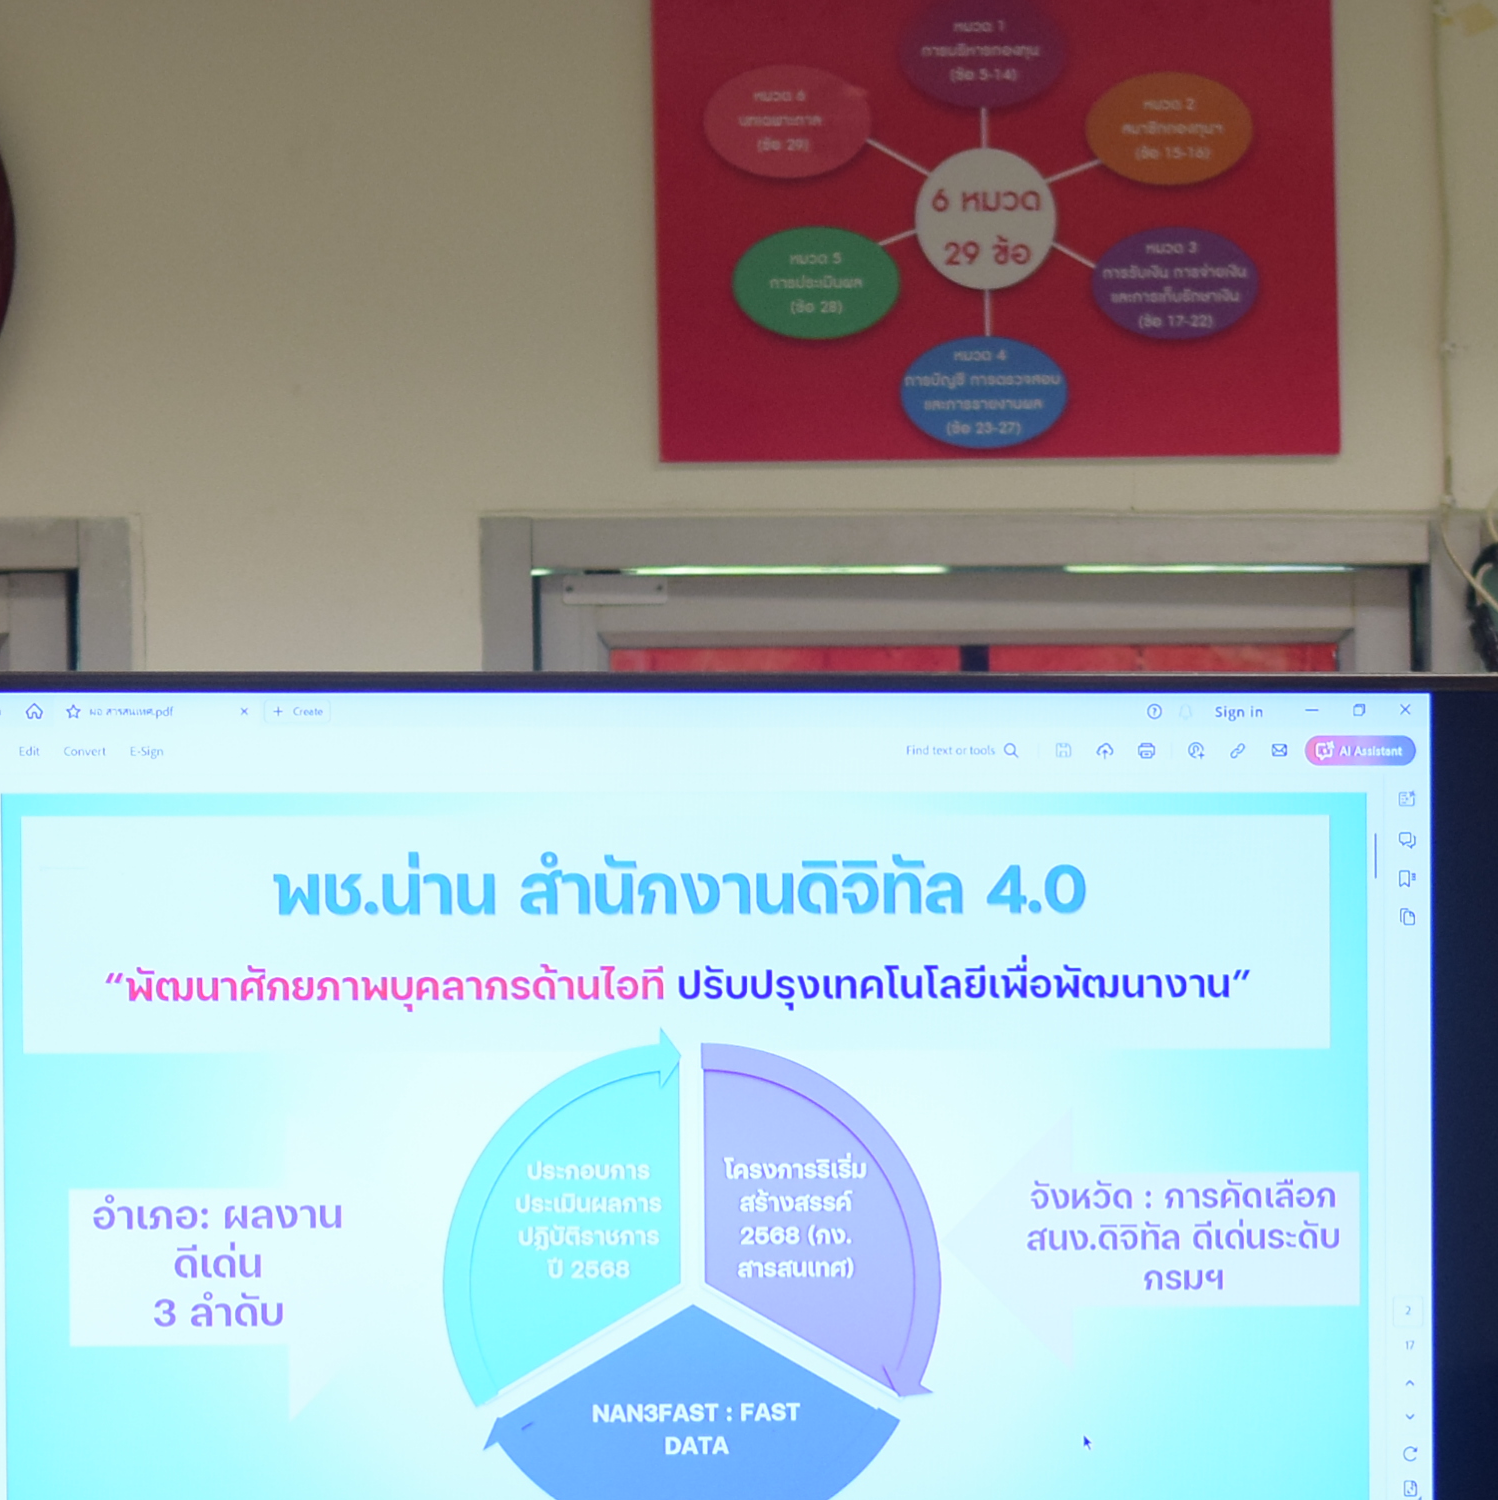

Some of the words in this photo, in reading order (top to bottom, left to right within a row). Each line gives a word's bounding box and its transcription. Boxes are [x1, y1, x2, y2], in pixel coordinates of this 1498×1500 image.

[931, 188, 949, 212] 6
[961, 189, 1041, 212] หมวด
[944, 240, 980, 265] 29
[991, 238, 1031, 265] ข้อ
[292, 706, 323, 716] Create
[1215, 705, 1245, 721] Sign
[1250, 705, 1263, 717] in
[18, 745, 39, 756] Edit
[63, 746, 105, 756] Convert
[129, 746, 164, 759] E-Sign
[905, 744, 929, 755] Find
[932, 746, 952, 755] text
[954, 747, 967, 755] or
[969, 744, 995, 755] tools
[1340, 746, 1351, 756] AI
[1354, 745, 1402, 756] Assistant
[273, 852, 496, 919] พช.น่าน
[520, 850, 963, 920] สำนักงานดิจิทัล
[982, 854, 1091, 920] 4.0
[526, 1160, 650, 1180] ประกอบการ
[723, 1156, 868, 1181] โครงการริเริ่ม
[515, 1192, 662, 1213] ประเมินผลการ
[739, 1188, 852, 1212] สร้างสรรค์
[1030, 1179, 1132, 1209] จังหวัด
[1164, 1178, 1335, 1208] การคัดเลือก
[92, 1193, 208, 1230] อำเภอ:
[224, 1204, 341, 1229] ผลงาน
[518, 1223, 659, 1251] ปฏิบัติราชการ
[740, 1225, 801, 1245] 2568
[806, 1223, 851, 1246] (กง.
[1026, 1220, 1179, 1250] สนง.ดิจิทัล
[1192, 1218, 1339, 1249] ดีเด่นระดับ
[174, 1241, 261, 1278] ดีเด่น
[546, 1256, 563, 1279] ปี
[570, 1259, 630, 1279] 2568
[737, 1256, 855, 1278] สารสนเทศ)
[1143, 1265, 1223, 1292] กรมฯ
[153, 1298, 176, 1327] 3
[190, 1291, 283, 1327] ลำดับ
[1405, 1305, 1411, 1315] 2
[1405, 1339, 1415, 1350] 17
[592, 1402, 719, 1423] NAN3FAST
[740, 1402, 800, 1421] FAST
[664, 1435, 729, 1455] DATA
